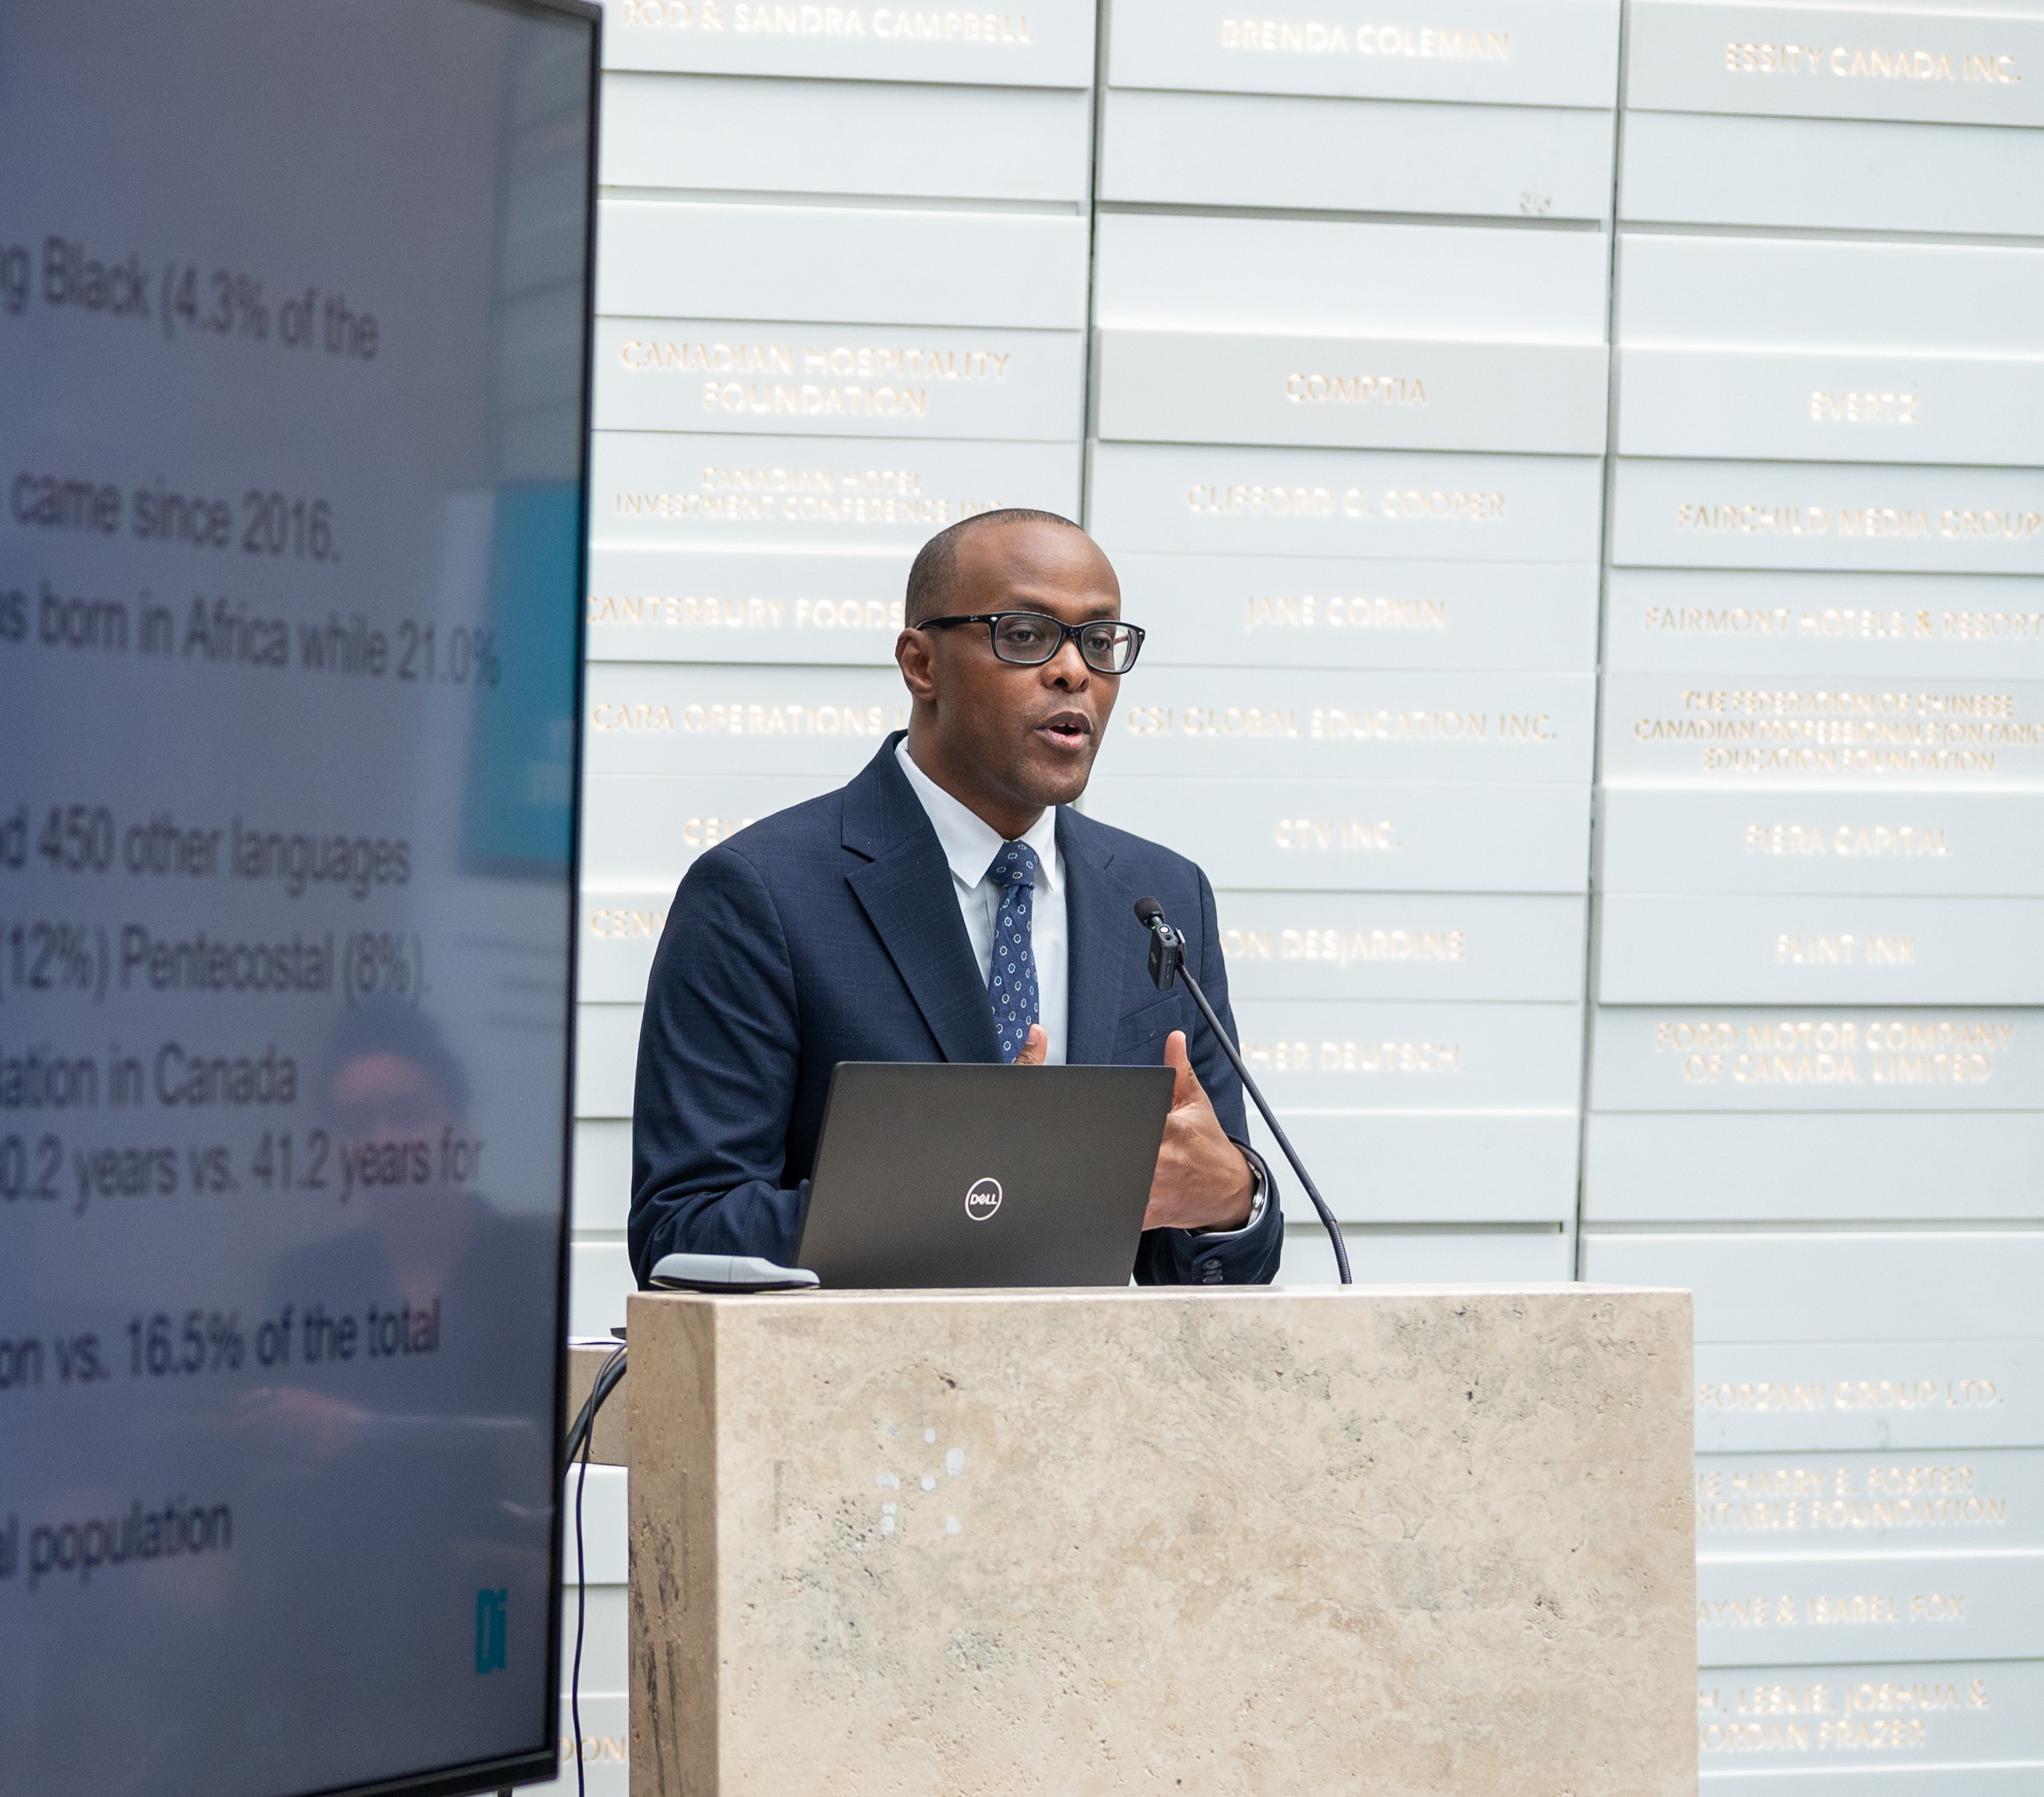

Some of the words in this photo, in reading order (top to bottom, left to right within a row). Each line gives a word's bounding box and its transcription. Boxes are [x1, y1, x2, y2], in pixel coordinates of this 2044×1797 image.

[622, 0, 693, 28] ROD
[700, 0, 726, 31] &
[733, 3, 864, 37] SANDRA
[872, 9, 1036, 43] CAMPBELL
[1222, 19, 1348, 54] BRENDA
[1356, 24, 1510, 60] COLEMAN
[1726, 43, 1821, 74] ESSITY
[1831, 47, 1953, 78] CANADA
[1964, 54, 2022, 83] INC.
[43, 235, 150, 322] Black
[160, 258, 268, 341] (4.3%
[279, 285, 316, 349] of
[324, 293, 380, 361] the
[621, 340, 793, 375] CANADIAN
[804, 347, 1010, 380] HOSPITALITY
[704, 382, 927, 417] FOUNDATION
[1285, 373, 1427, 405] COMPTIA
[1811, 391, 1919, 423] EVERTZ
[702, 467, 835, 494] CANADIAN
[843, 469, 925, 496] HOTEL
[11, 472, 122, 535] came
[133, 475, 232, 548] since
[242, 487, 341, 564] 2016.
[616, 494, 775, 520] INVESTMENT
[783, 496, 950, 523] CONFERENCE
[1188, 485, 1335, 517] CLIFFORD
[1344, 488, 1374, 518] G.
[1382, 489, 1506, 521] COOPER
[1679, 503, 1830, 535] FAIRCHILD
[1839, 508, 1932, 538] MEDIA
[1940, 509, 2042, 540] GROUP
[795, 598, 905, 630] FOODS
[1245, 593, 1319, 632] JANE
[1327, 596, 1446, 629] CORKIN
[1645, 606, 1792, 636] FAIRMONT
[1800, 609, 1906, 638] HOTELS
[1913, 610, 1934, 638] &
[39, 580, 129, 653] born
[138, 588, 174, 656] in
[183, 593, 289, 668] Africa
[303, 609, 387, 677] while
[398, 618, 501, 687] 21.0%
[593, 703, 674, 733] CARA
[684, 704, 886, 735] OPERATIONS
[1682, 690, 1727, 716] THE
[1732, 691, 1875, 717] FEDERATION
[1881, 693, 1912, 716] OF
[1917, 693, 2013, 718] CHINESE
[1128, 707, 1173, 734] CSI
[1183, 707, 1301, 737] GLOBAL
[1312, 708, 1486, 738] EDUCATION
[1499, 713, 1558, 740] INC.
[1634, 719, 1755, 744] CANADIAN
[1759, 719, 1939, 745] PROFESSIONALS
[1703, 747, 1837, 772] EDUCATION
[1843, 748, 1996, 773] FOUNDATION
[1274, 819, 1334, 850] CTV
[1341, 820, 1402, 850] INC.
[1745, 824, 1828, 855] FIERA
[1835, 825, 1952, 855] CAPITAL
[39, 803, 116, 875] 450
[124, 810, 223, 878] other
[232, 817, 413, 900] languages
[0, 921, 111, 1007] 12%)
[120, 923, 334, 994] Pentecostal
[1282, 929, 1465, 968] DESJARDINE
[1778, 935, 1857, 965] FLINT
[1866, 936, 1917, 965] INK
[1657, 1022, 1738, 1052] FORD
[1748, 1022, 1859, 1052] MOTOR
[1866, 1022, 2015, 1052] COMPANY
[1320, 1042, 1460, 1071] DEUTSCH
[1684, 1054, 1724, 1083] OF
[1873, 1054, 1992, 1083] LIMITED
[109, 1040, 143, 1108] in
[157, 1040, 298, 1109] Canada
[74, 1145, 180, 1217] years
[188, 1145, 242, 1194] vs.
[250, 1127, 330, 1194] 41.2
[339, 1135, 432, 1204] years
[440, 1125, 486, 1189] for
[970, 1193, 998, 1205] DELL
[55, 1331, 111, 1384] vs.
[127, 1309, 244, 1378] 16.5%
[254, 1305, 295, 1366] of
[302, 1301, 356, 1363] the
[367, 1296, 441, 1357] total
[1700, 1382, 1825, 1413] FORZANI
[1835, 1381, 1936, 1411] GROUP
[1945, 1379, 2004, 1408] LTD.
[1732, 1469, 1827, 1498] HARRY
[1836, 1468, 1858, 1496] E.
[1868, 1466, 1974, 1496] FOSTER
[1811, 1498, 2007, 1529] FOUNDATION
[29, 1497, 233, 1592] population
[1776, 1594, 1797, 1626] &
[1807, 1595, 1900, 1625] ISABEL
[1909, 1592, 1966, 1622] FOX
[1845, 1682, 1959, 1719] JOSHUA
[1968, 1678, 1989, 1710] &
[1819, 1719, 1926, 1750] FRAZER
